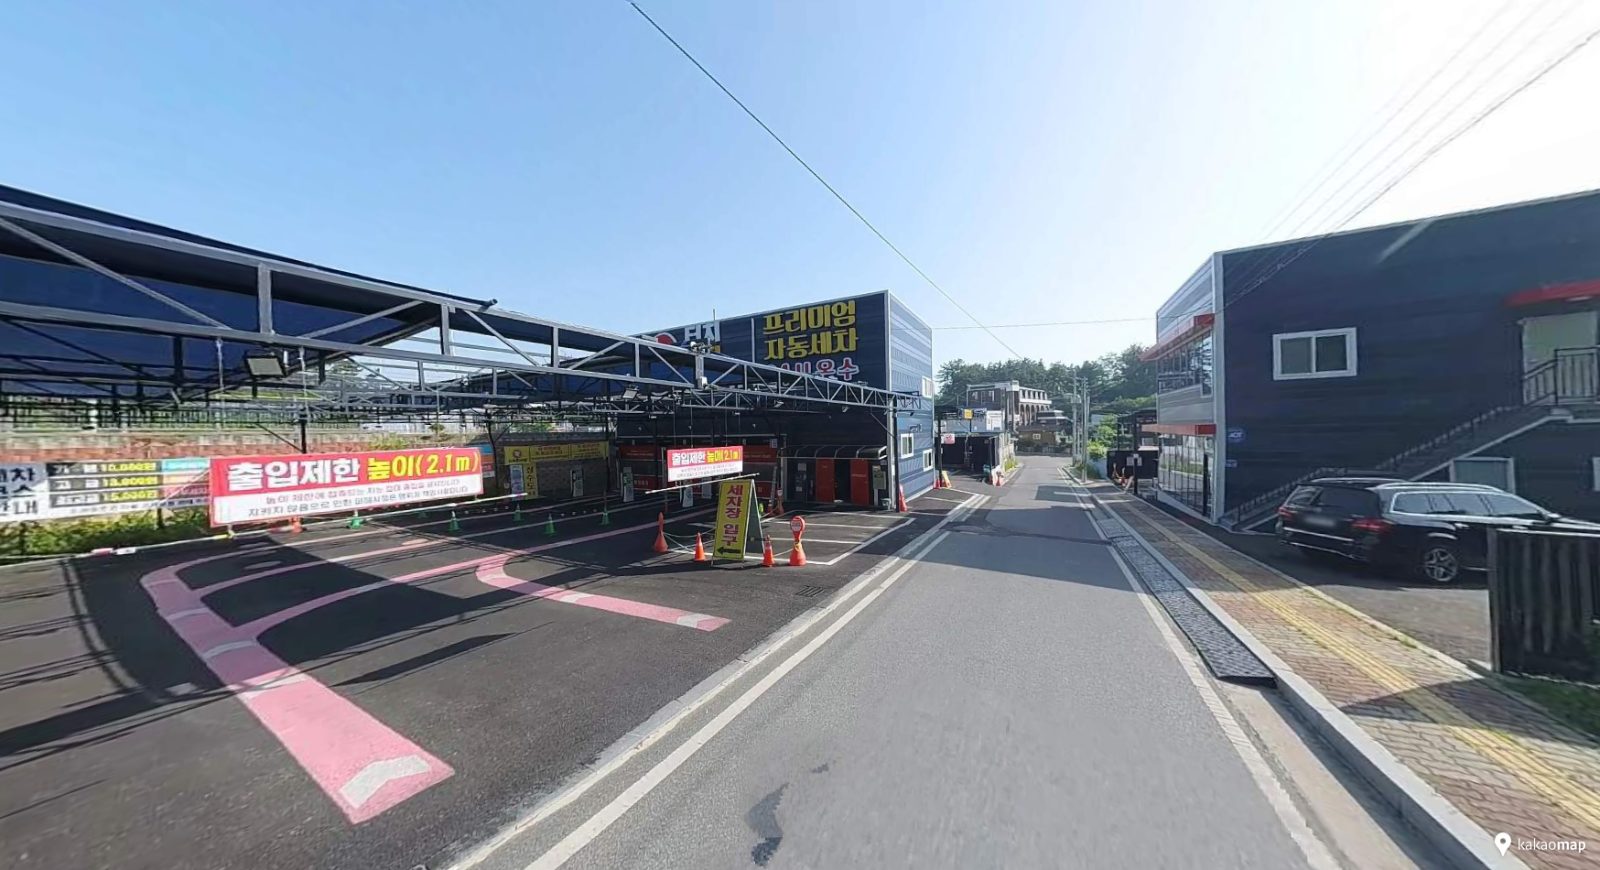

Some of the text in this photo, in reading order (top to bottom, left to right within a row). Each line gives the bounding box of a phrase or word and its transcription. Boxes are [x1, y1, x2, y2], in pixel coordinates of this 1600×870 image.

[763, 300, 856, 335] 프리미엄
[763, 327, 859, 360] 자동세차
[228, 451, 479, 492] 출입제한 높이(2.1m)
[672, 451, 705, 467] 출입제한
[721, 484, 743, 546] 세차장 입구
